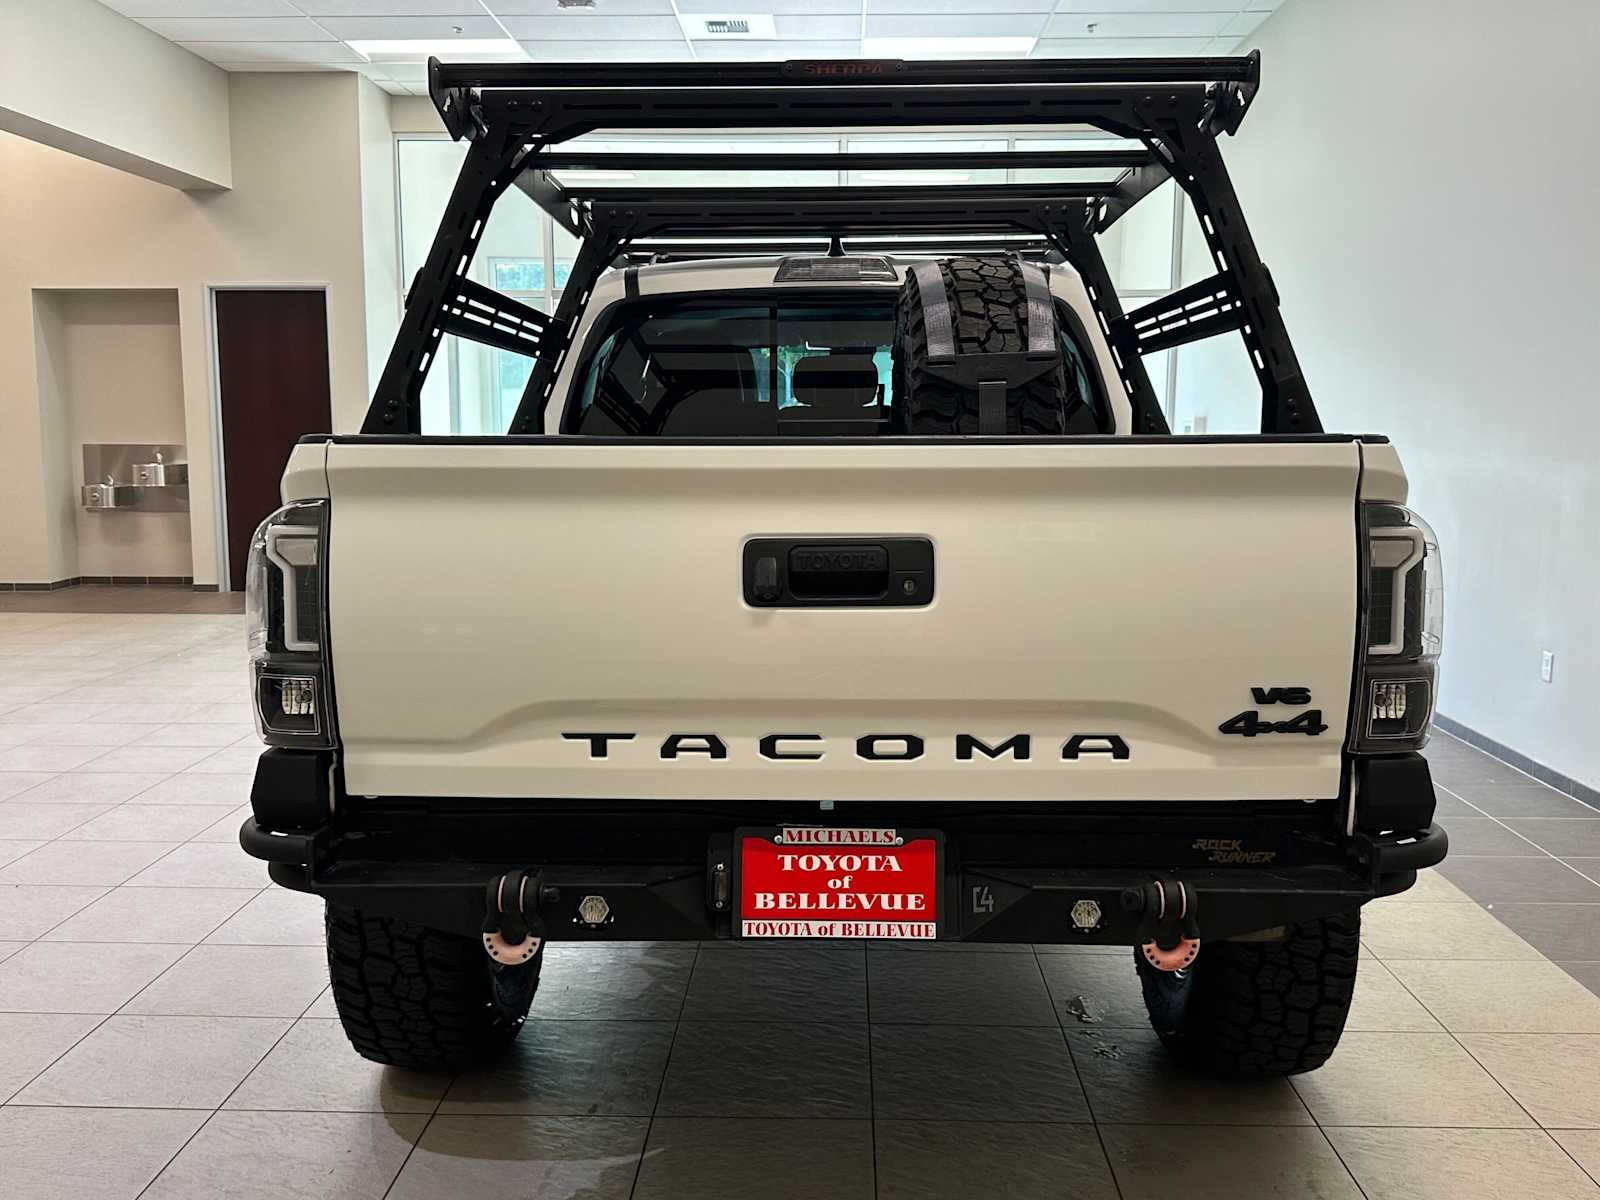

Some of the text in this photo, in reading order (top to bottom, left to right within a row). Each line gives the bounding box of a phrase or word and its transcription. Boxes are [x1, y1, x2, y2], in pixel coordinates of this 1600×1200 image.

[802, 62, 883, 76] SHERPA
[796, 552, 881, 570] TOYOTA
[1250, 686, 1312, 705] V6
[1219, 709, 1329, 737] 4x4
[560, 732, 1131, 760] TACOMA
[785, 829, 895, 844] MICHAELS
[1192, 838, 1242, 851] ROCK
[777, 854, 903, 872] TOYOTA
[1208, 850, 1276, 863] RUNNER
[827, 875, 853, 889] of
[754, 893, 925, 911] BELLEVUE
[743, 922, 935, 938] TOYOTA of BELLEVUE
